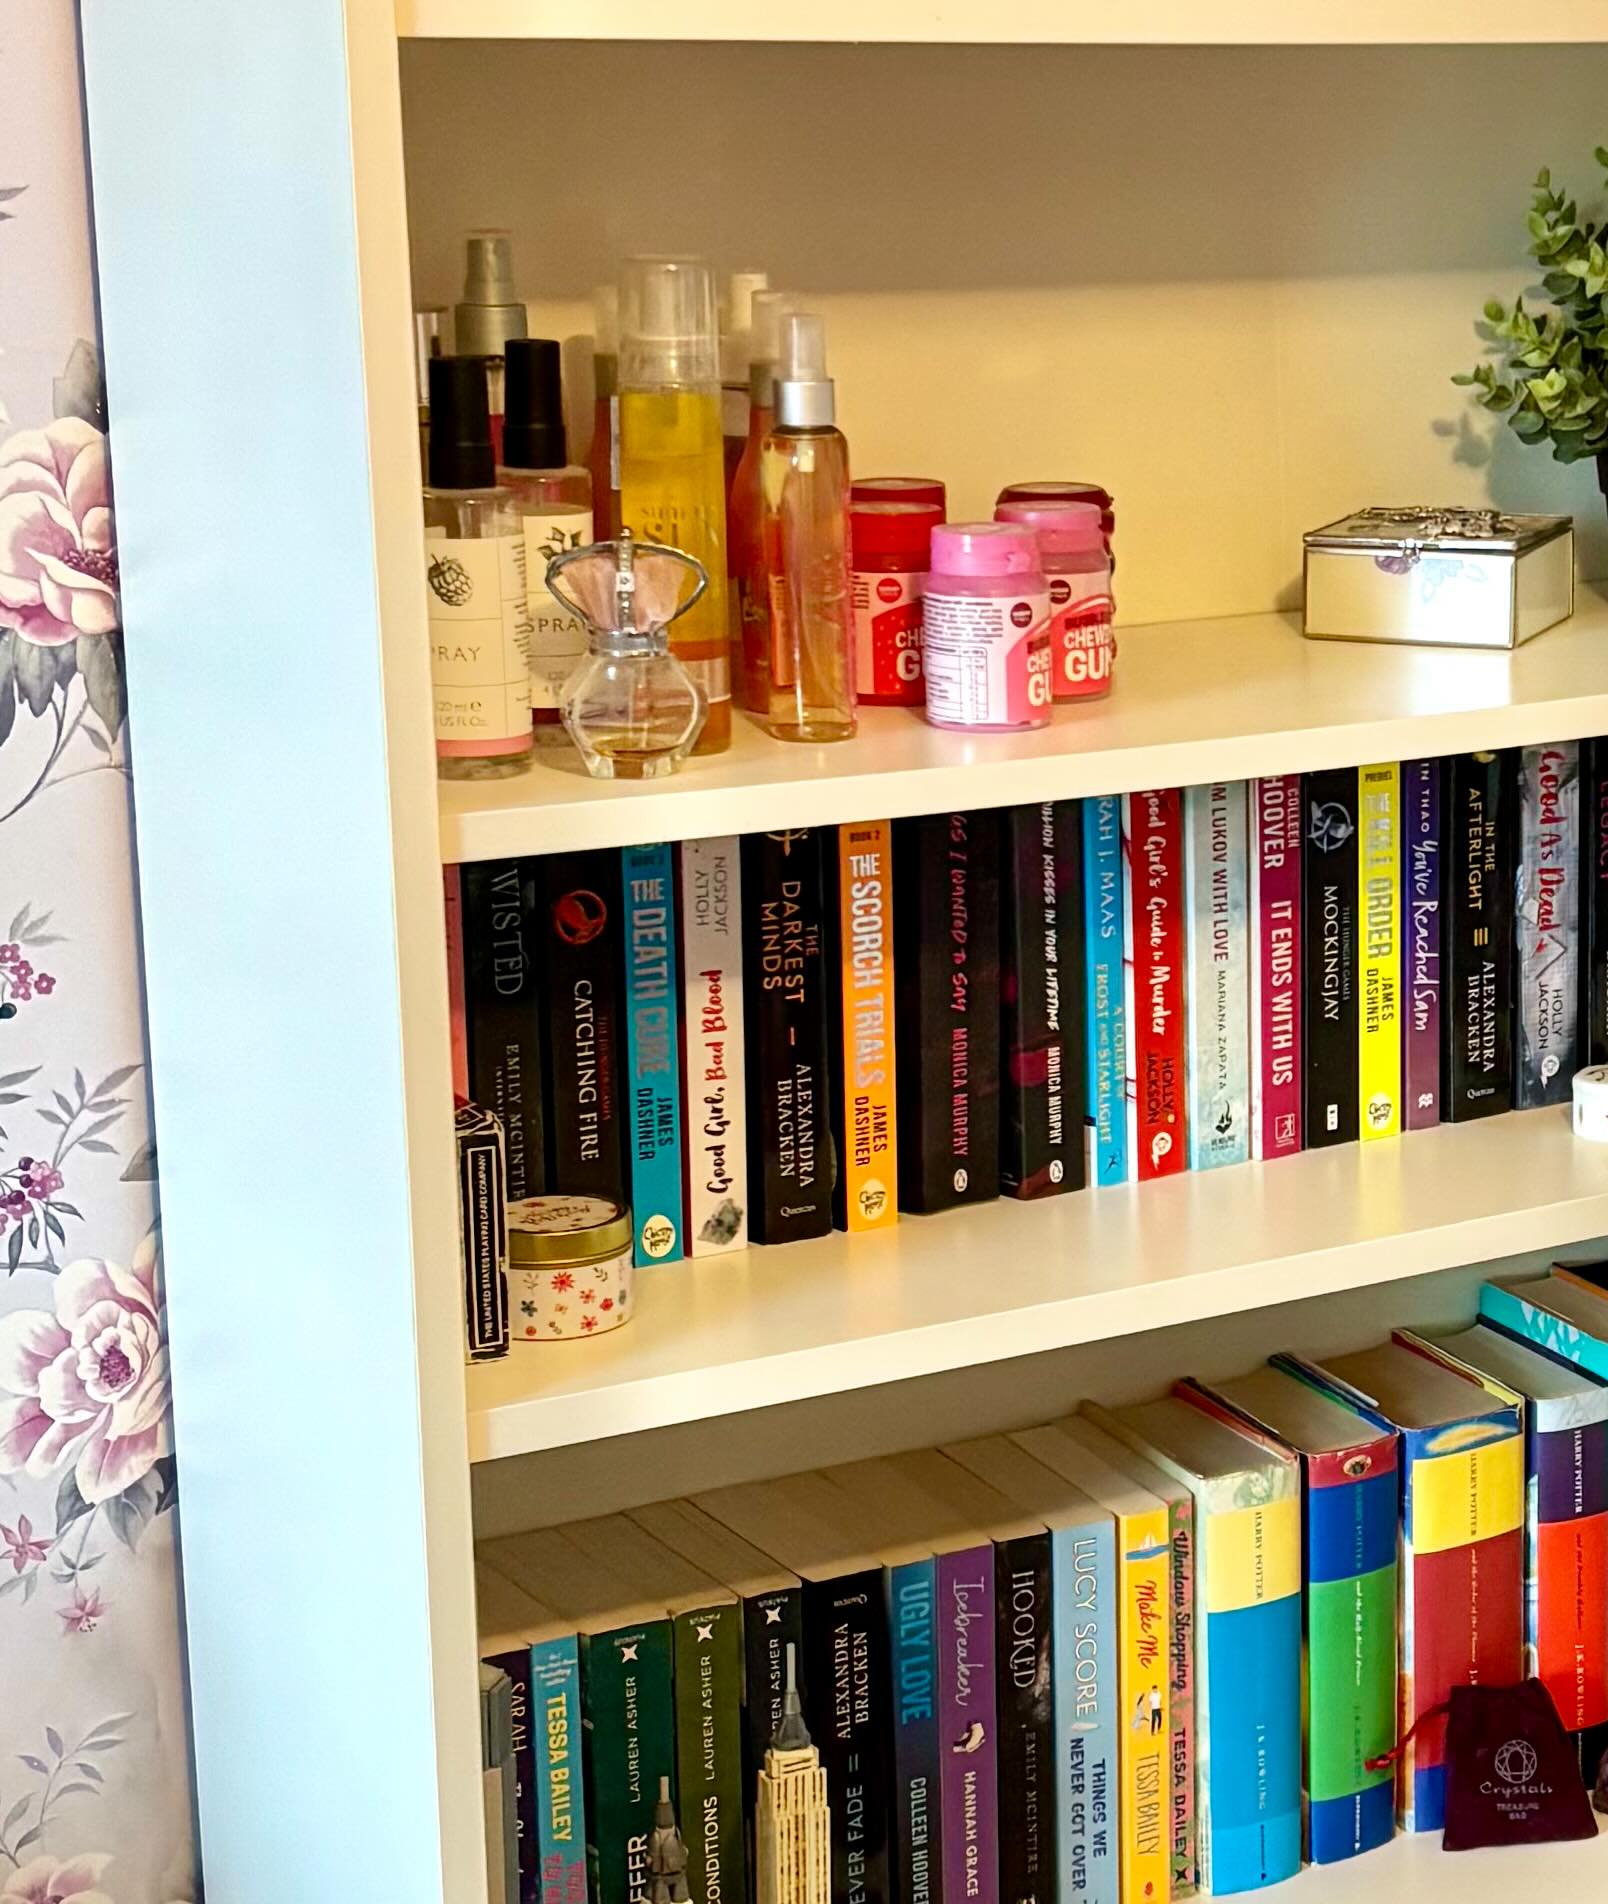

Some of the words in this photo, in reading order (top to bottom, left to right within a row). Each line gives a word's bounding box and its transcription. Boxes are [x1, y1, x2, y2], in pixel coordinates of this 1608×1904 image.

[527, 616, 587, 633] SPRA
[432, 646, 480, 662] RAY
[1537, 750, 1567, 826] Good
[1042, 802, 1054, 848] ILLION
[1263, 777, 1285, 869] HOOVER
[1286, 788, 1300, 848] COLLEEN
[1485, 821, 1494, 837] IN
[1540, 832, 1561, 860] As
[848, 853, 880, 876] THE
[1143, 837, 1168, 888] Girl's
[1414, 840, 1438, 896] You've
[1468, 787, 1482, 911] AFTERLIGHT
[1485, 841, 1495, 871] THE
[630, 878, 664, 901] THE
[696, 868, 710, 926] HOLLY
[712, 855, 729, 935] JACKSON
[1043, 854, 1056, 905] KISSES
[1538, 867, 1565, 932] Dead
[491, 867, 529, 996] WISTED
[851, 880, 883, 990] SCORCH
[1047, 907, 1056, 925] IN
[1145, 898, 1168, 949] Guide
[1271, 900, 1291, 920] IT
[631, 906, 669, 1002] DEATH
[761, 901, 782, 991] MINDS
[782, 880, 805, 1003] DARKEST
[806, 923, 820, 956] THE
[1044, 930, 1057, 963] YOUR
[1271, 924, 1293, 987] ENDS
[1322, 885, 1340, 1021] MOCKINGJAY
[1342, 932, 1350, 968] HUNGER
[1412, 899, 1439, 986] Reached
[700, 969, 723, 1034] Blood
[1044, 968, 1059, 1032] LIFETIME
[1148, 964, 1172, 1034] Murder
[1217, 970, 1225, 1032] MARIANA
[1342, 970, 1351, 1001] GAMES
[1366, 968, 1379, 1034] DASHNER
[1382, 977, 1395, 1021] JAMES
[1414, 988, 1438, 1032] Sam
[1553, 988, 1563, 1036] HOLLY
[573, 979, 598, 1104] CATCHING
[854, 996, 886, 1090] TRIALS
[1271, 992, 1293, 1056] WITH
[1468, 975, 1480, 1063] BRACKEN
[1482, 961, 1496, 1073] ALEXANDRA
[1538, 981, 1550, 1050] JACKSON
[634, 1010, 671, 1080] CURE
[704, 1041, 725, 1081] Bad
[952, 1027, 968, 1089] MONICA
[1047, 1046, 1060, 1094] MONICA
[1218, 1037, 1226, 1090] ZAPATA
[1272, 1061, 1293, 1087] US
[1146, 1052, 1160, 1125] JACKSON
[1161, 1056, 1174, 1114] HOLLY
[578, 1111, 600, 1162] FIRE
[637, 1087, 657, 1162] DASHNER
[657, 1096, 674, 1148] JAMES
[703, 1087, 730, 1142] Girl,
[776, 1078, 795, 1178] BRACKEN
[796, 1063, 814, 1189] ALEXANDRA
[853, 1096, 871, 1167] DASHNER
[871, 1103, 888, 1153] JAMES
[952, 1096, 969, 1158] MURPHY
[1048, 1096, 1061, 1145] MURPHY
[478, 1153, 487, 1188] COMPANY
[706, 1145, 733, 1194] Good
[481, 1251, 493, 1282] STATES
[483, 1284, 495, 1315] UNITED
[483, 1316, 495, 1341] THE
[1470, 1453, 1478, 1491] HARRY
[1574, 1429, 1583, 1470] HARRY
[1470, 1494, 1478, 1537] POTTER
[1575, 1472, 1583, 1514] POTTER
[1255, 1511, 1264, 1549] HARRY
[1072, 1537, 1097, 1611] LUCY
[1172, 1530, 1191, 1607] Window
[1254, 1554, 1264, 1599] POTTER
[899, 1581, 929, 1655] UGLY
[1012, 1570, 1035, 1689] HOOKED
[1135, 1580, 1160, 1632] Make
[952, 1577, 985, 1707] Icebreaker
[1074, 1622, 1098, 1717] SCORE
[1136, 1635, 1160, 1670] Me
[1169, 1611, 1191, 1692] Shopping
[626, 1676, 638, 1730] ASHER
[701, 1655, 712, 1709] ASHER
[835, 1622, 852, 1739] ALEXANDRA
[853, 1631, 868, 1722] BRACKEN
[901, 1660, 930, 1725] LOVE
[547, 1692, 567, 1763] TESSA
[701, 1715, 715, 1781] LAUREN
[628, 1737, 640, 1804] LAUREN
[1025, 1731, 1036, 1783] EMILY
[1070, 1737, 1084, 1795] NEVER
[1136, 1753, 1160, 1801] TESSA
[549, 1768, 573, 1842] BAILEY
[847, 1784, 863, 1843] FADE
[910, 1776, 928, 1846] COLLEEN
[964, 1771, 977, 1840] HANNAH
[1071, 1800, 1085, 1837] GOT
[1092, 1758, 1107, 1823] THINGS
[1480, 1781, 1552, 1798] Crystals
[1025, 1788, 1037, 1874] MCINTIRE
[1093, 1828, 1106, 1857] WE
[1136, 1804, 1160, 1856] BAILEY
[965, 1844, 978, 1897] GRACE
[1072, 1843, 1086, 1891] OVER
